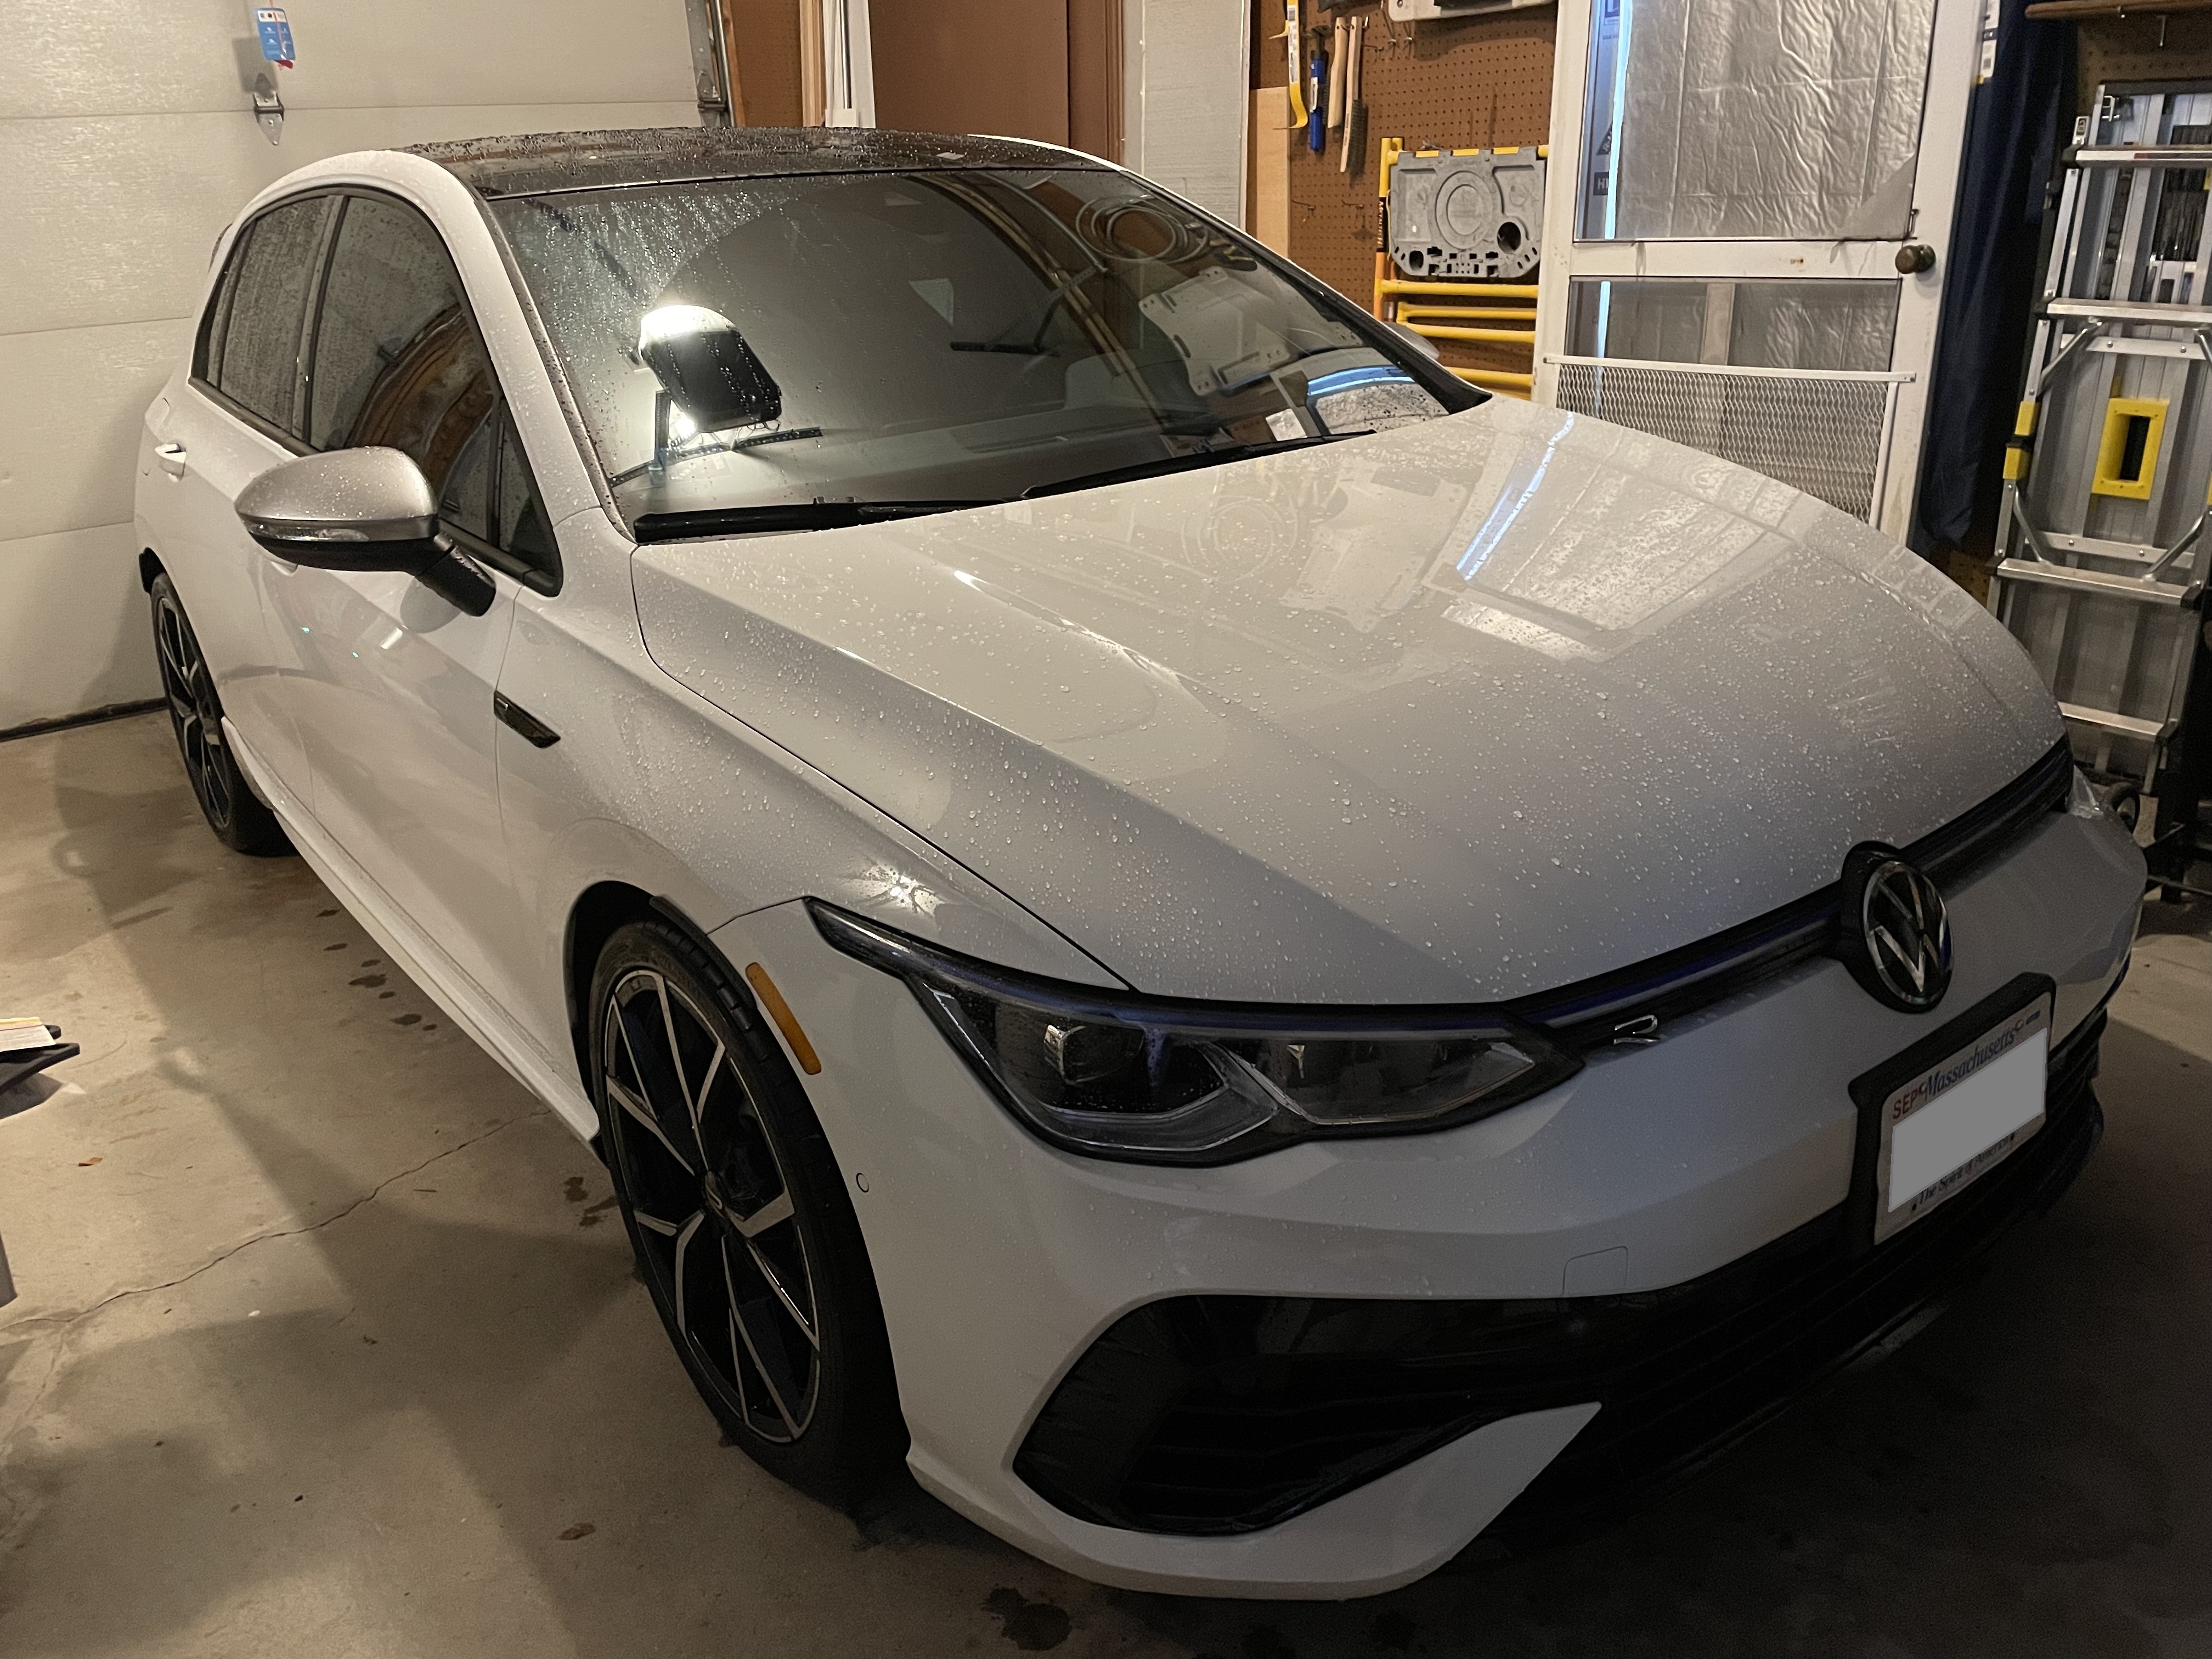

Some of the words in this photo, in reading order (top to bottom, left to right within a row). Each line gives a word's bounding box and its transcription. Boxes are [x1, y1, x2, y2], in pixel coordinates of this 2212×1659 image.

[1613, 1014, 1660, 1045] R
[1893, 1089, 1918, 1120] SEP
[1927, 1026, 2015, 1096] Massachusetts
